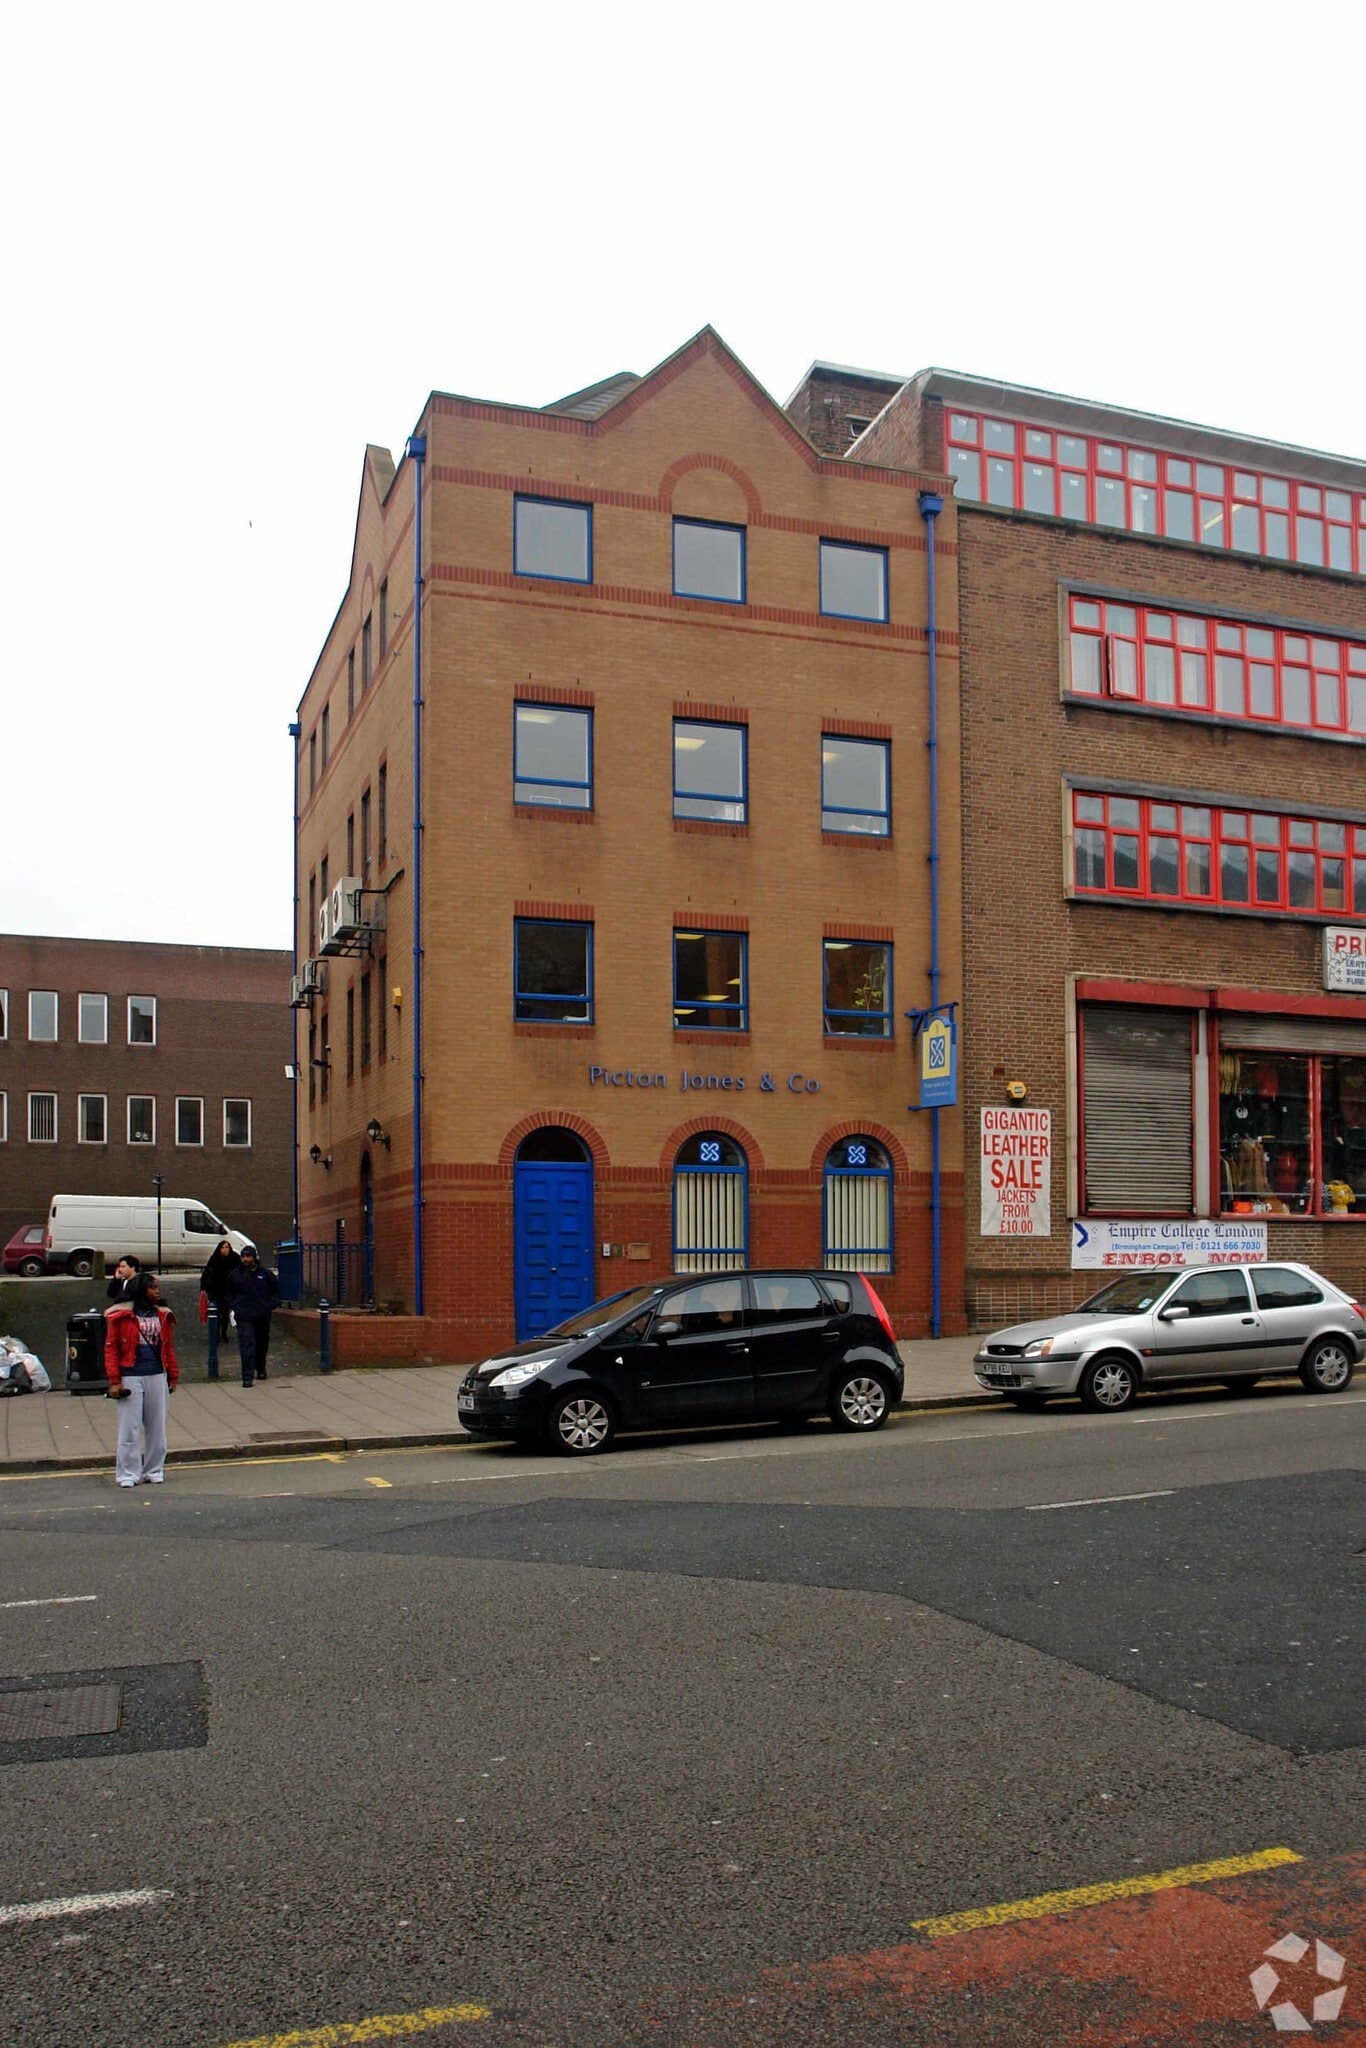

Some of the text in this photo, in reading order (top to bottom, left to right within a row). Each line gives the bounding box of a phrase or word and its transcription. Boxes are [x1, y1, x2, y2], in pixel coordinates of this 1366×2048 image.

[589, 1064, 820, 1093] Picton Jones & Co
[984, 1110, 1049, 1131] GIGANTIC
[983, 1134, 1049, 1157] LEATHER
[990, 1158, 1043, 1190] SALE
[996, 1189, 1036, 1204] JACKETS
[1002, 1204, 1030, 1218] FROM
[1000, 1220, 1033, 1234] £10.00
[1108, 1222, 1264, 1242] Empire College London
[1181, 1241, 1194, 1250] Tel
[1200, 1241, 1221, 1250] 0121
[1223, 1241, 1239, 1250] 666
[1240, 1241, 1261, 1250] 7030
[1102, 1252, 1187, 1266] ENROL
[1207, 1253, 1265, 1264] NOW
